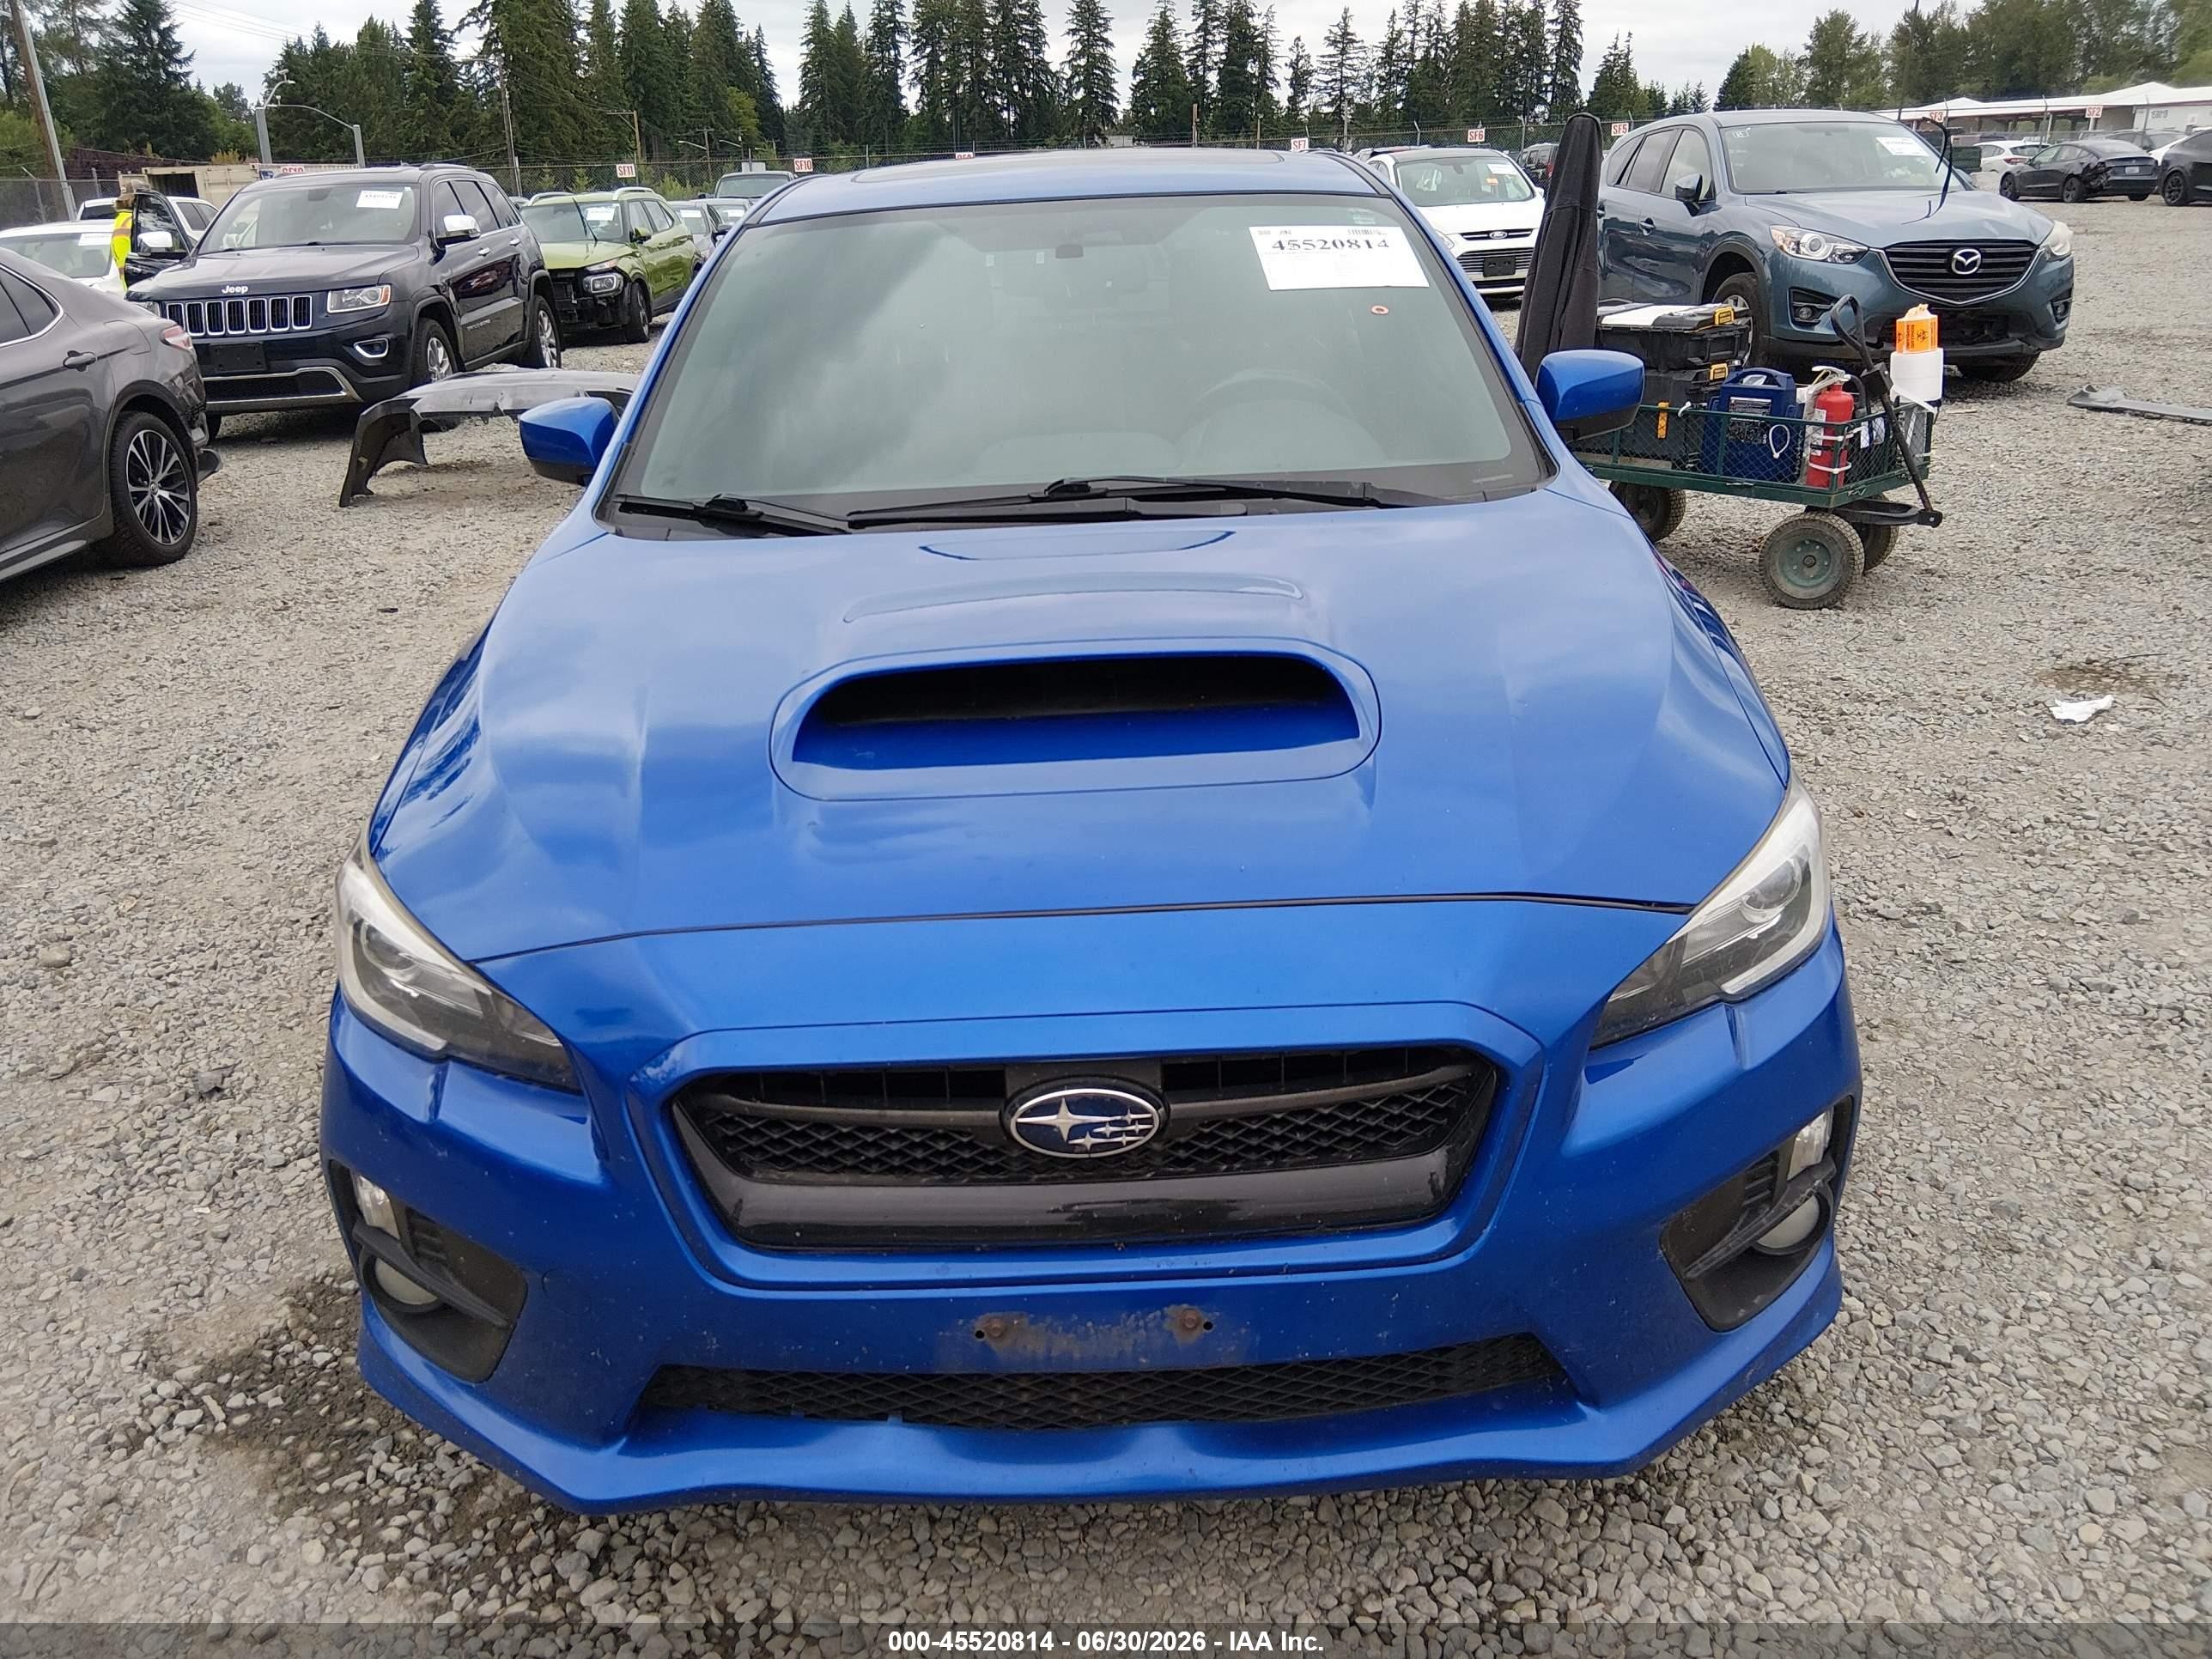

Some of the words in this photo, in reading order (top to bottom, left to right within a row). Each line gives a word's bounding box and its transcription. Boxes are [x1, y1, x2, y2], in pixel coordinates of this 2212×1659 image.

[2087, 106, 2100, 116] SF2
[1613, 124, 1627, 134] SF5
[1469, 131, 1484, 141] SF6
[1292, 139, 1306, 150] SF7
[618, 165, 634, 176] SF11
[795, 160, 812, 171] SF10
[1272, 239, 1389, 251] 45520814
[221, 285, 248, 294] Jeep
